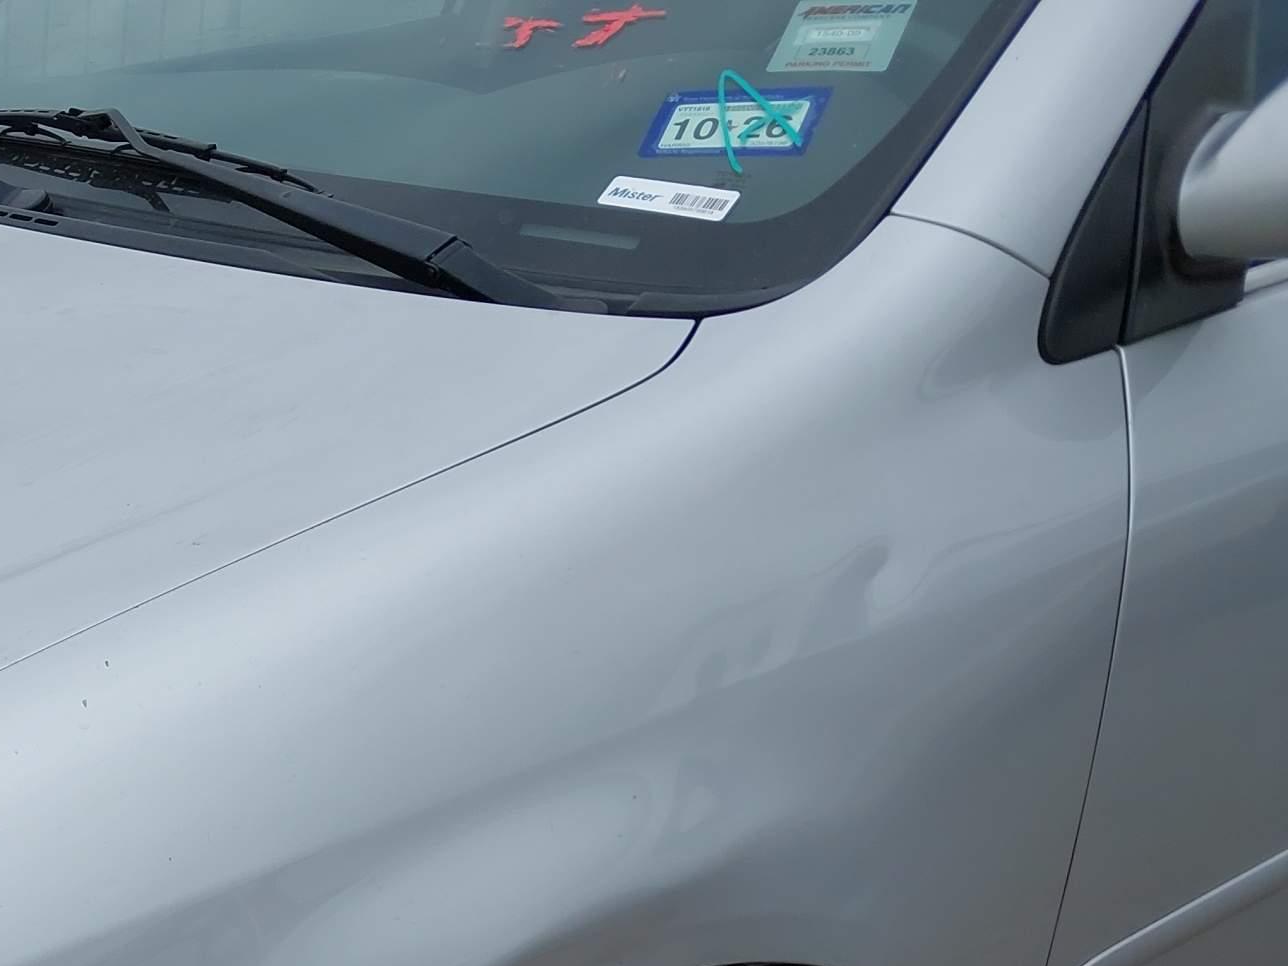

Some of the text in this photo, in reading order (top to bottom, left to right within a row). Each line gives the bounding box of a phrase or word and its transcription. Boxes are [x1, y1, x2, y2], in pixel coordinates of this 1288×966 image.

[798, 4, 911, 19] AMERICAN
[808, 47, 856, 57] 23863
[673, 118, 719, 141] 10
[608, 187, 664, 202] Mister
